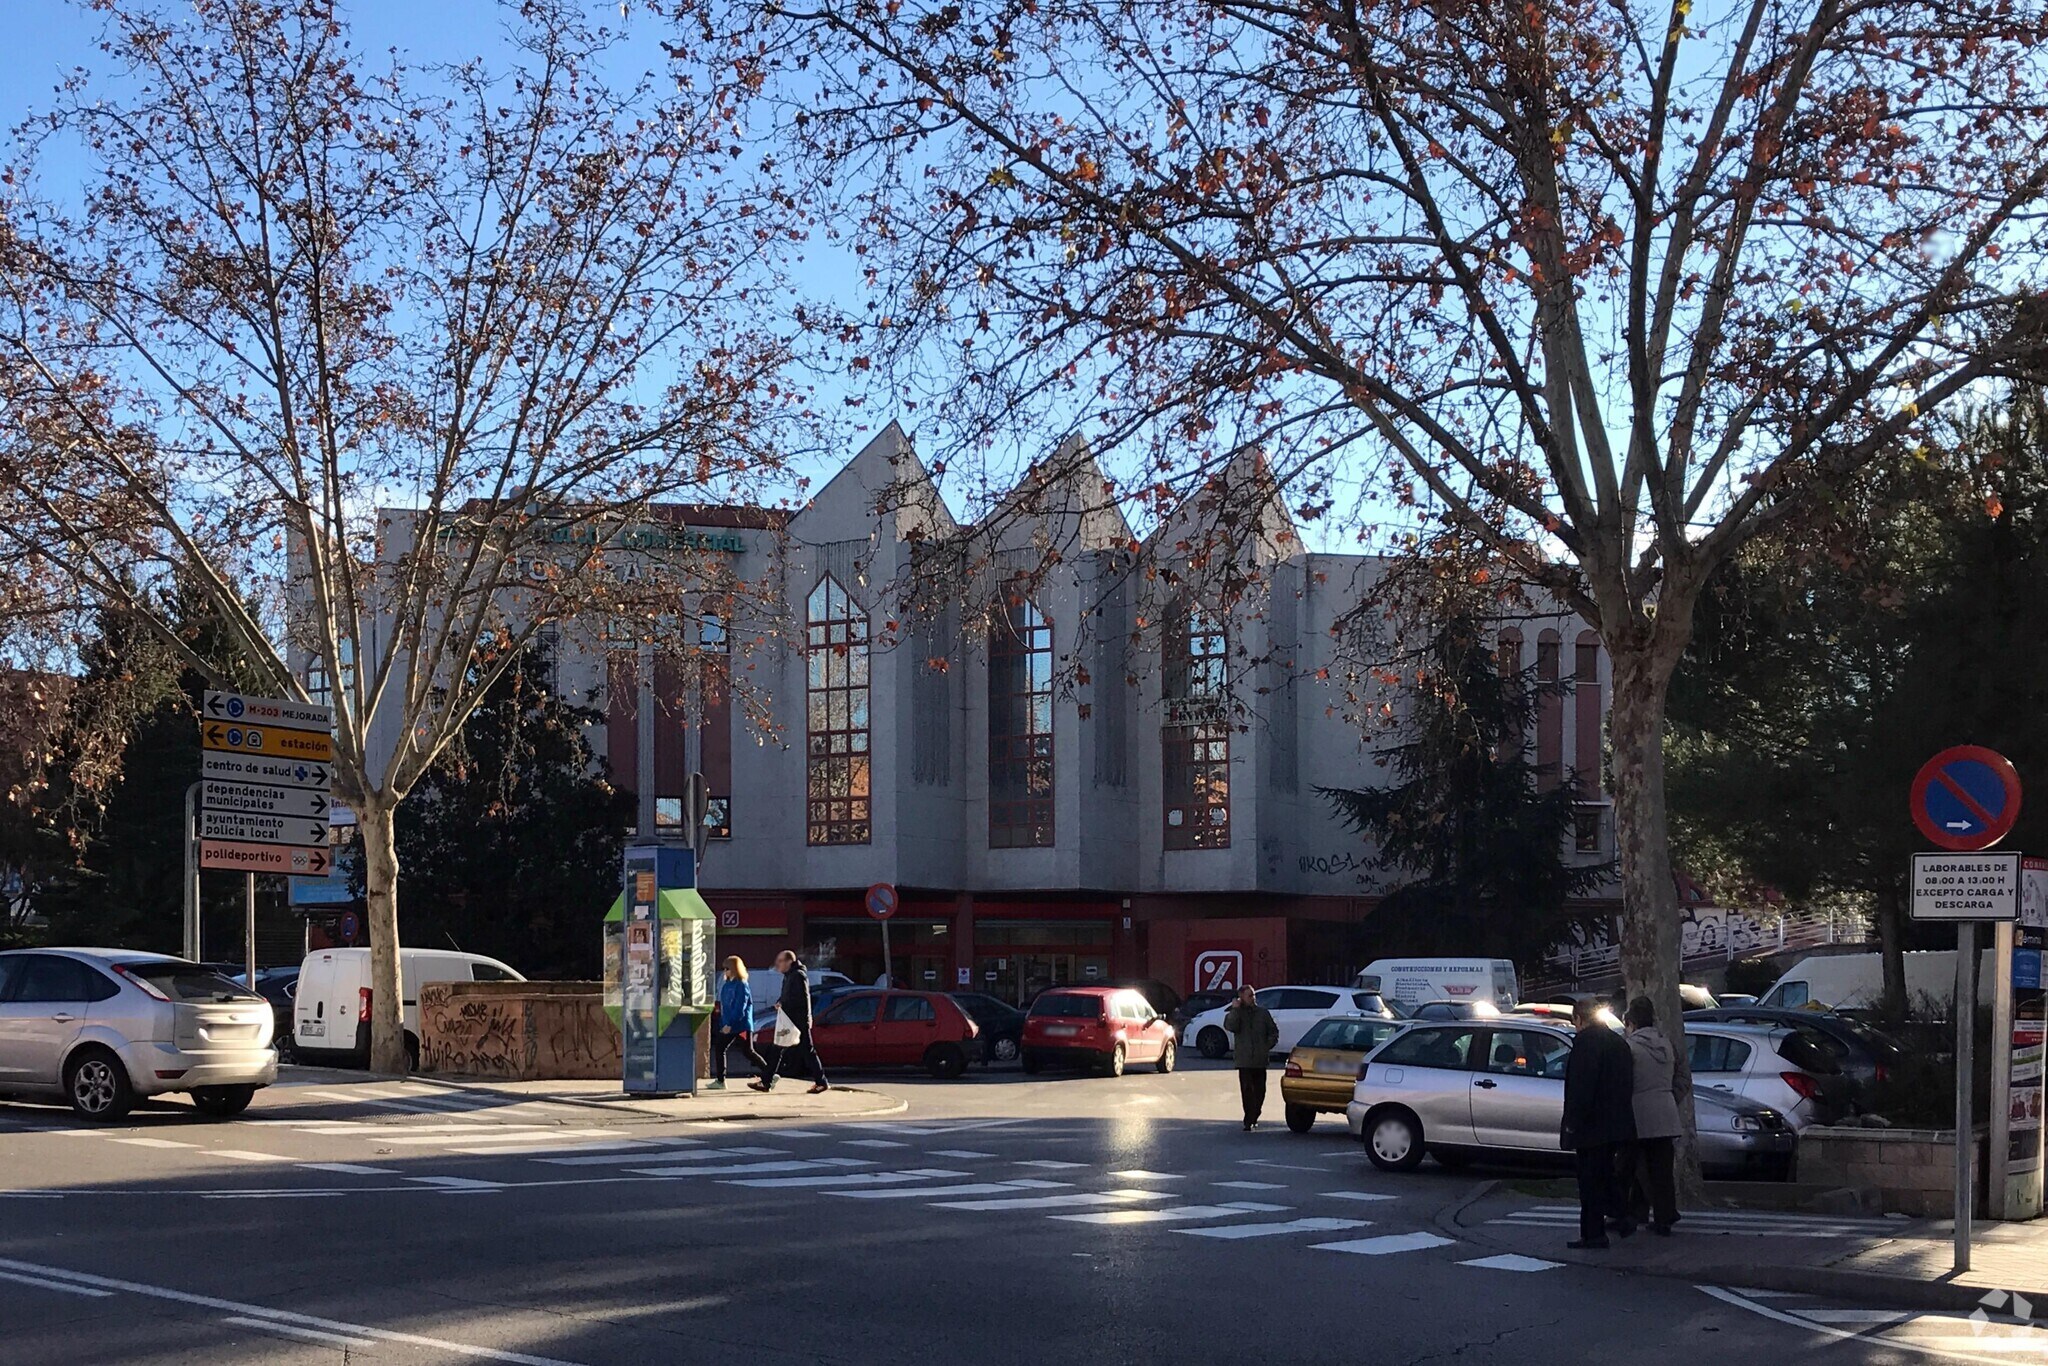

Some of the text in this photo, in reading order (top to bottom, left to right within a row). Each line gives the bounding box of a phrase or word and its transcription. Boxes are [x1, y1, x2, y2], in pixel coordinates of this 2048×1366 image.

[249, 705, 329, 722] M-203 MEJORADA
[280, 737, 328, 752] estación
[206, 760, 291, 777] centro de salud
[206, 783, 285, 800] dependencias
[206, 795, 274, 810] municipales
[206, 814, 284, 829] ayuntamiento
[205, 825, 279, 839] policía local
[205, 847, 282, 863] polideportivo
[1922, 863, 2008, 873] LABORABLES DE
[1957, 876, 1965, 884] A
[1997, 876, 2005, 884] H
[1916, 888, 2014, 896] EXCEPTO CARGA Y
[1935, 901, 1993, 909] DESCARGA
